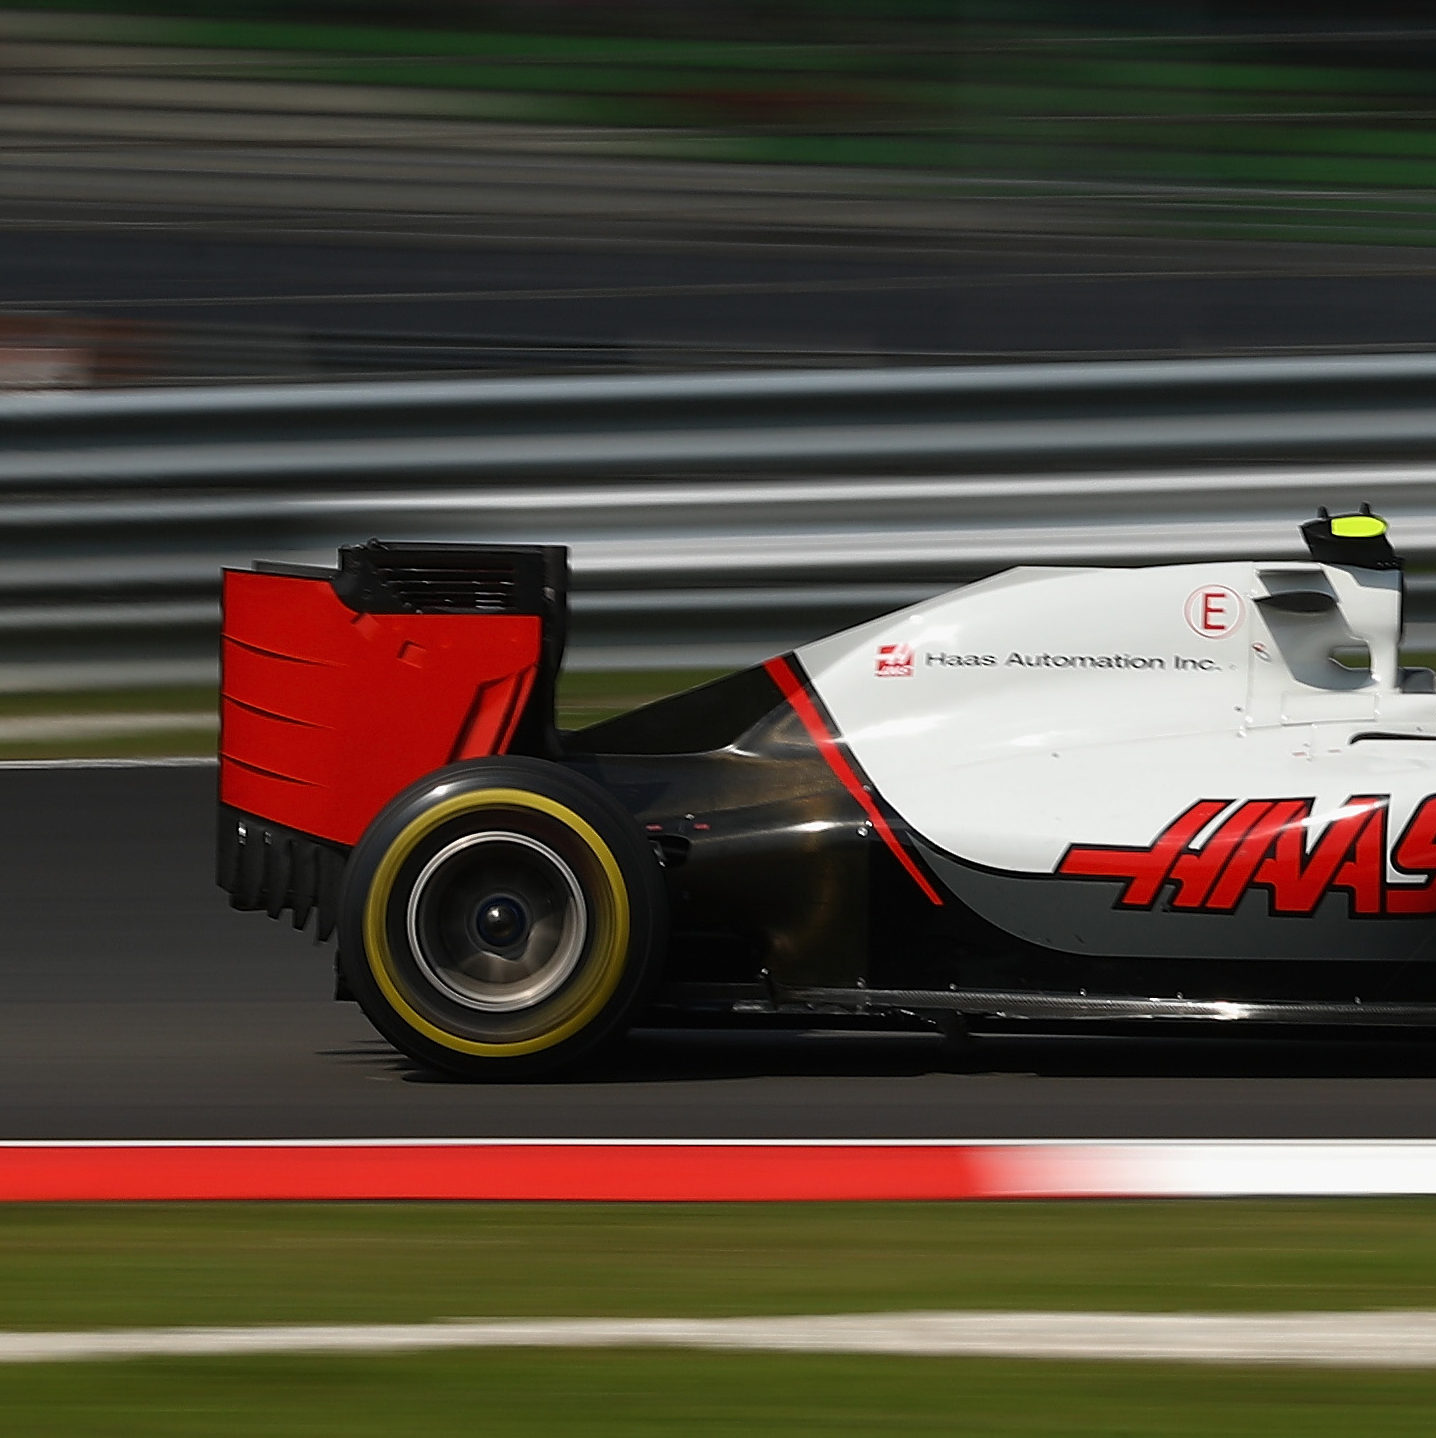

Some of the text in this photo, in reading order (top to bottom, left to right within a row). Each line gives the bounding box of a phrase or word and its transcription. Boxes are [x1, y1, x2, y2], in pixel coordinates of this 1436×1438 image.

[1203, 593, 1226, 630] E
[926, 651, 1223, 671] Haas Automation Inc.
